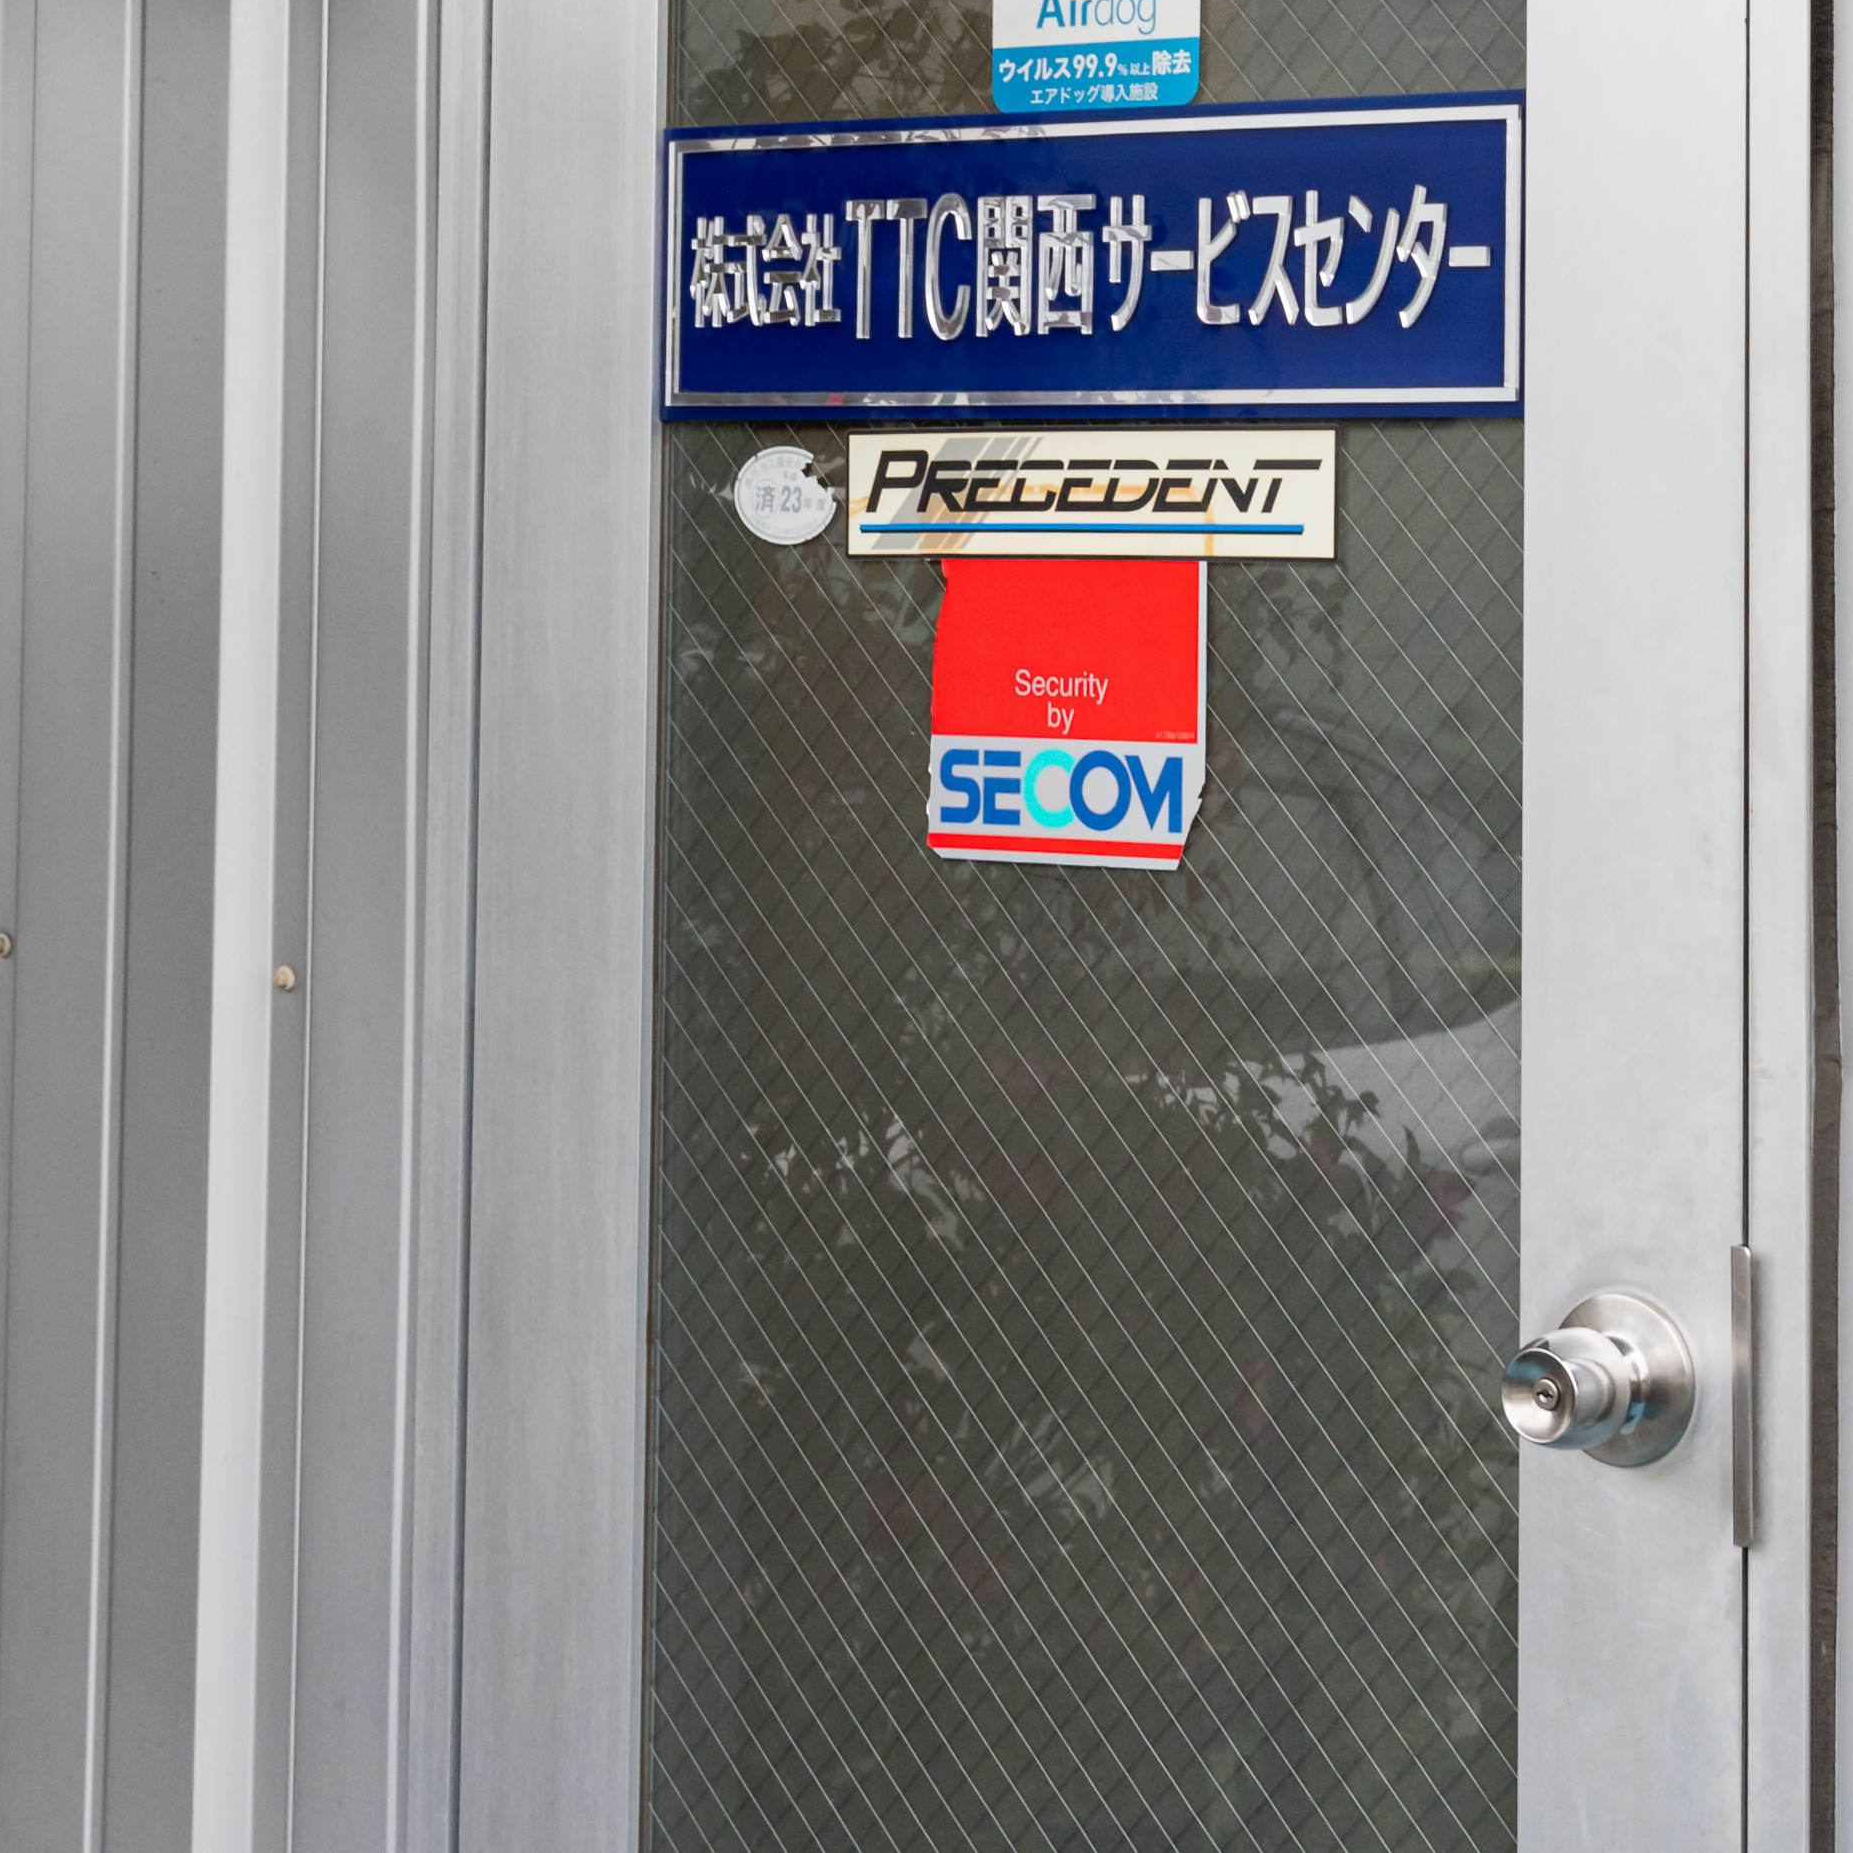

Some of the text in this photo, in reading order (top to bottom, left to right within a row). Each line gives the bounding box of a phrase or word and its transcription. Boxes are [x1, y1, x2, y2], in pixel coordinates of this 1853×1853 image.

[755, 484, 776, 513] 済
[866, 450, 1322, 514] PRECEDENT
[1014, 669, 1108, 704] Security
[1045, 702, 1075, 734] by
[939, 748, 1184, 835] SECOM
